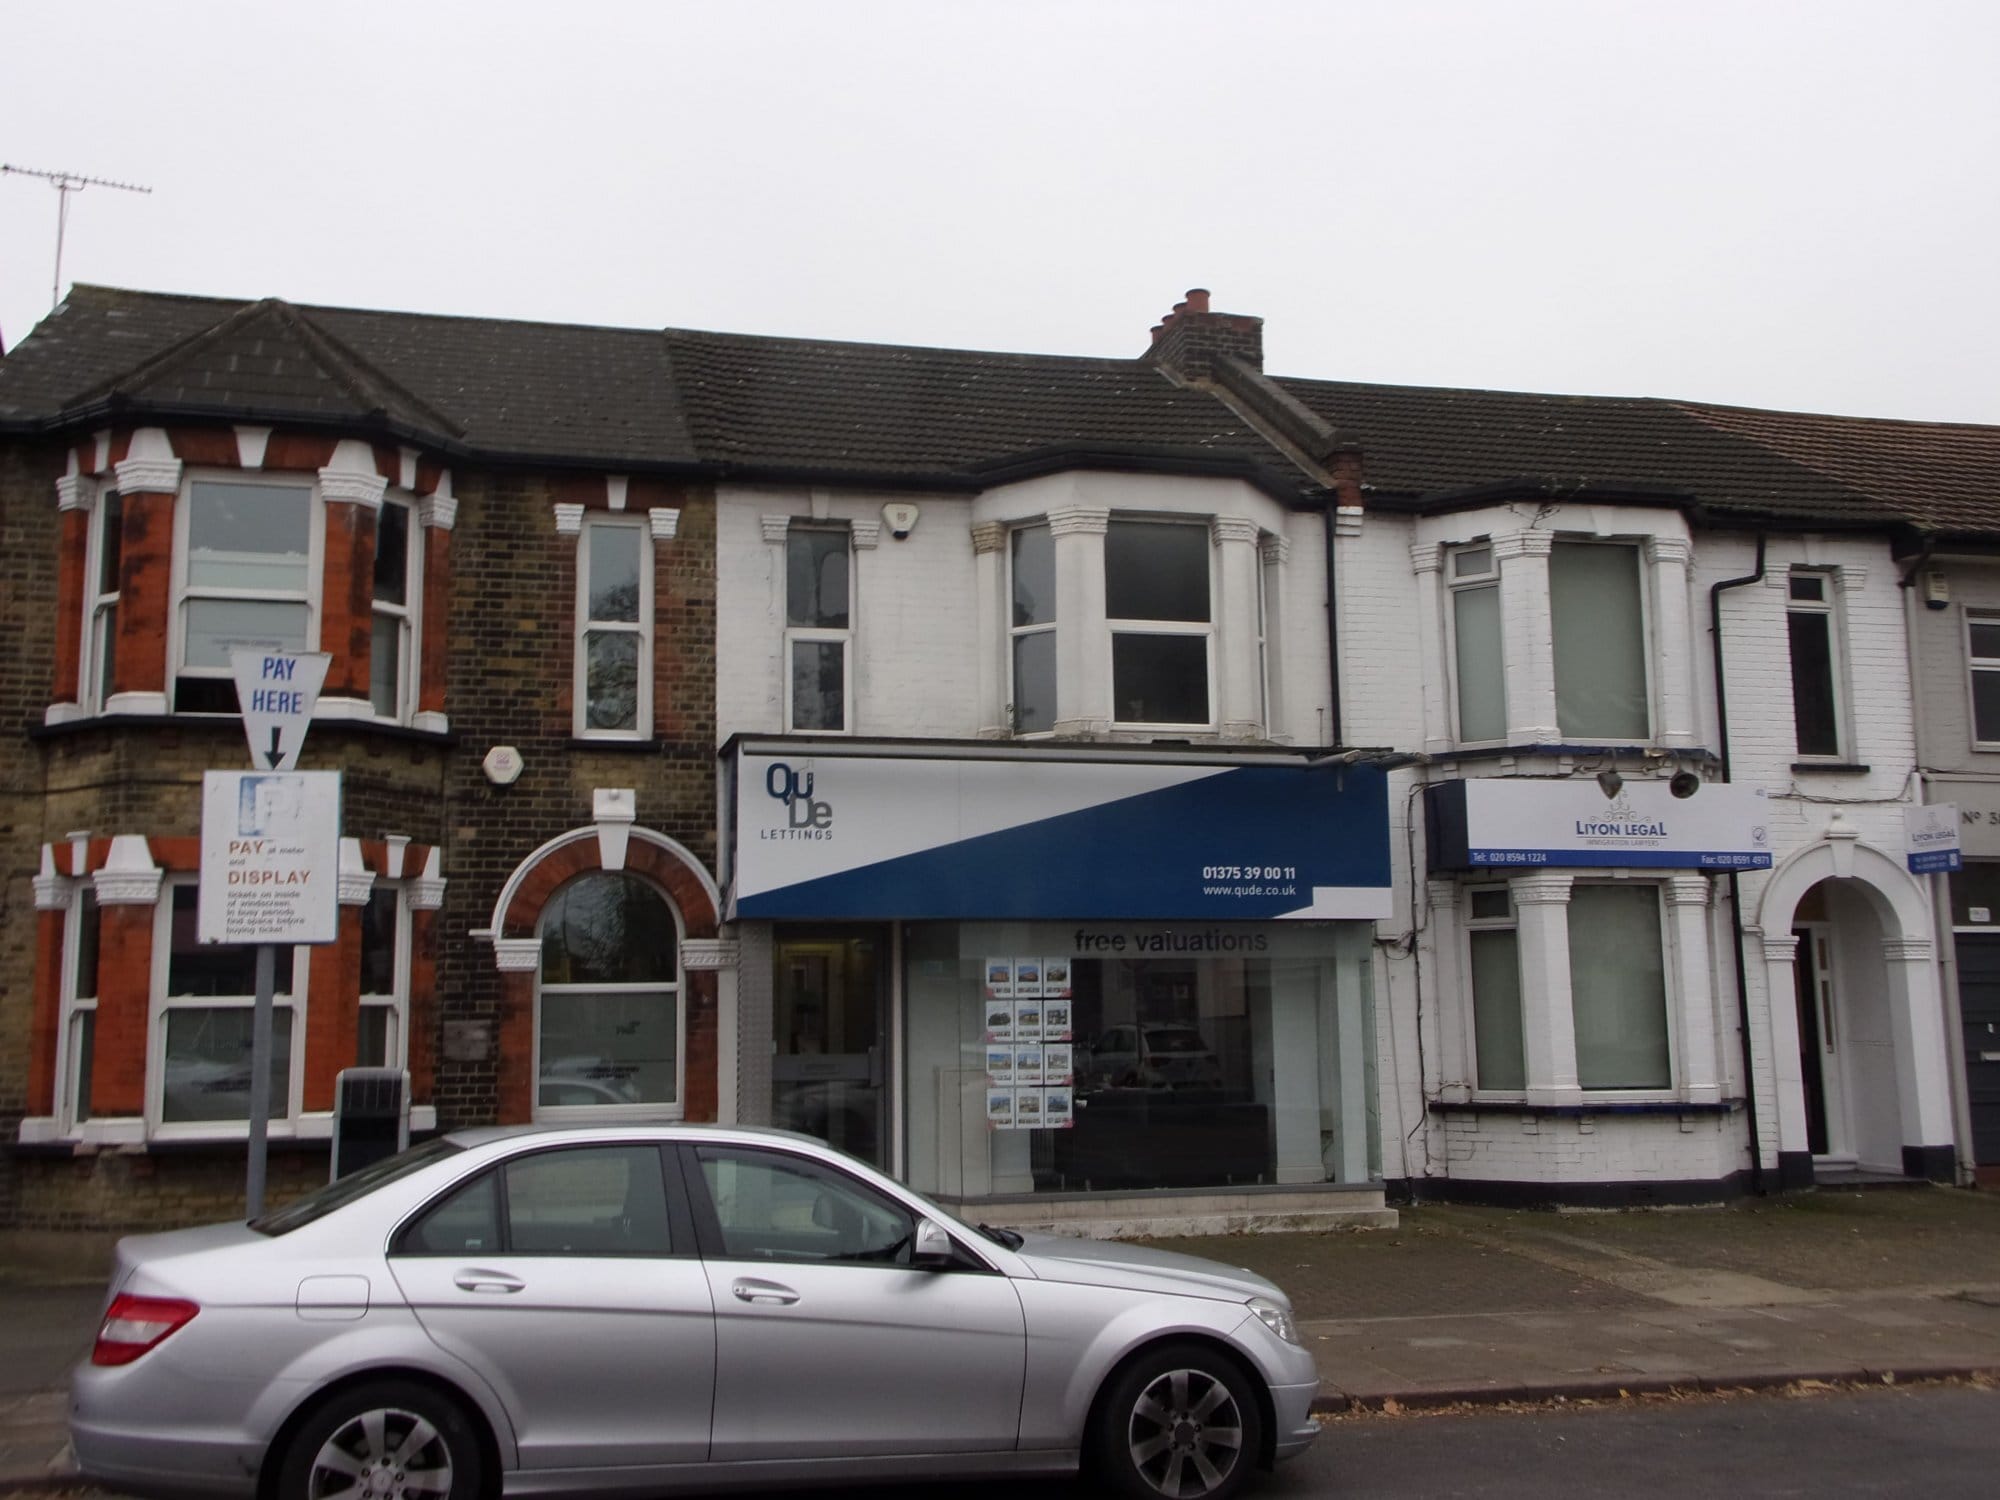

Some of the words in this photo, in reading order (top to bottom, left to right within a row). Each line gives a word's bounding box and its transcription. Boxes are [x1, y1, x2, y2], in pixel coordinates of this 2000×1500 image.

[262, 656, 296, 680] PAY
[252, 689, 303, 714] HERE
[760, 828, 833, 841] LETTINGS
[229, 840, 264, 854] PAY
[1490, 852, 1505, 862] 020
[1506, 853, 1526, 862] 8594
[1528, 853, 1547, 862] 1224
[1717, 855, 1731, 864] 020
[228, 870, 311, 885] DISPLAY
[1203, 866, 1241, 880] 01375
[1244, 866, 1261, 880] 39
[1264, 866, 1281, 880] 00
[1284, 866, 1296, 880] 11
[1203, 885, 1297, 898] www.qude.co.uk
[1074, 929, 1127, 952] free
[1136, 929, 1268, 953] valuations
